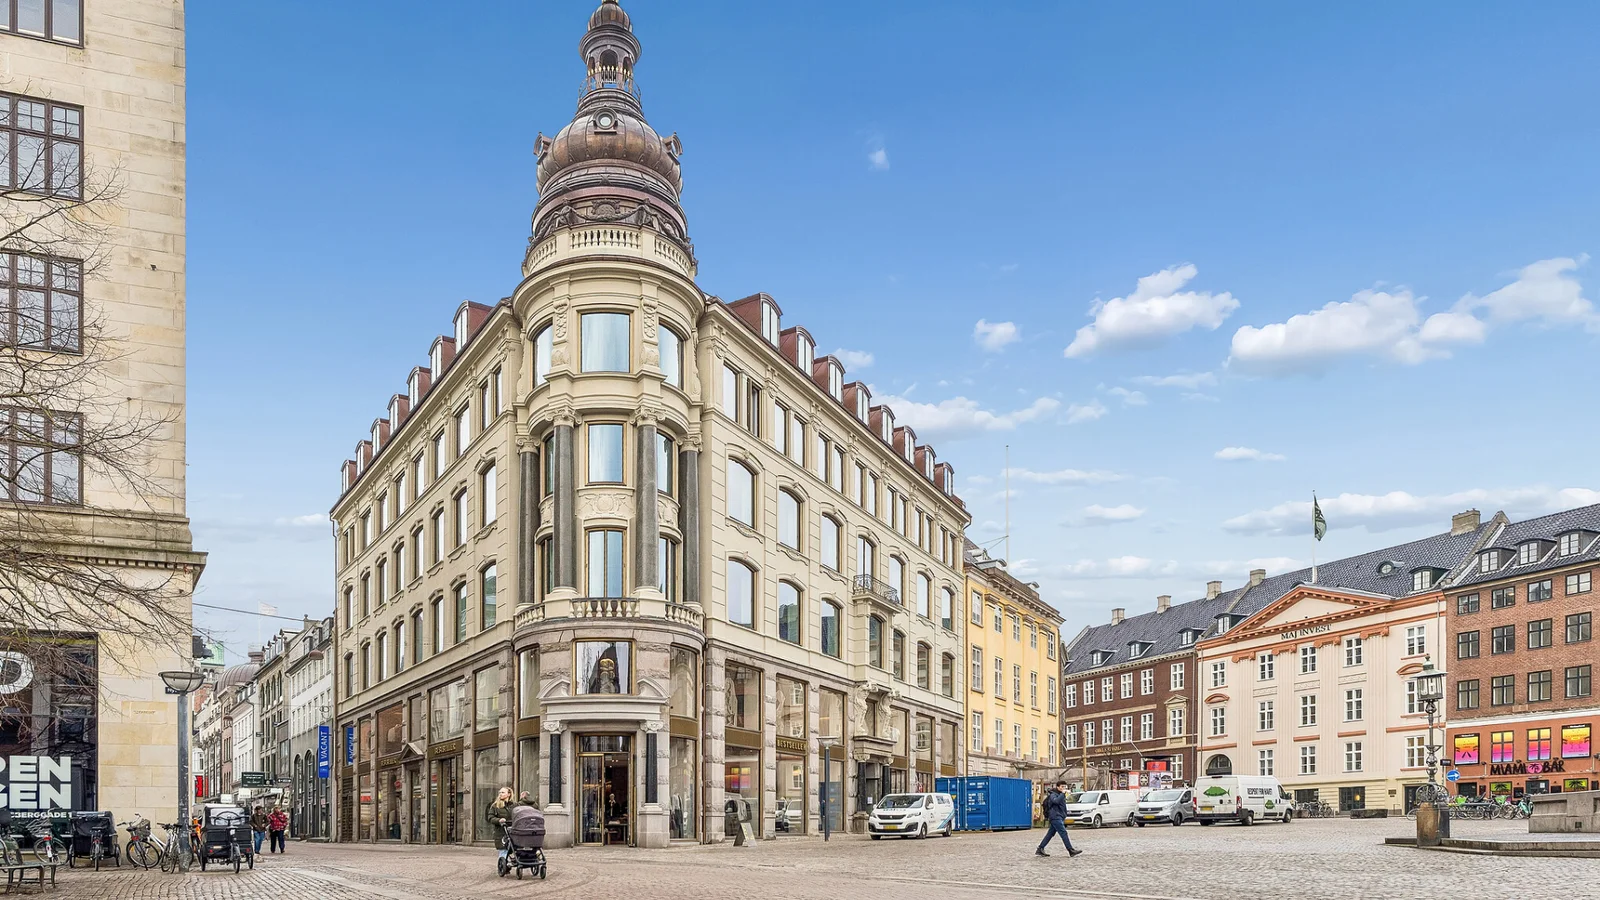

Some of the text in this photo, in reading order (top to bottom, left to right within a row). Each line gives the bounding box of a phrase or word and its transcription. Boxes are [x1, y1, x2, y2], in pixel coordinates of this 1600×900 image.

[1281, 624, 1332, 640] MAJ INVEST
[320, 731, 328, 760] VACANT
[1490, 763, 1527, 776] MIAMI
